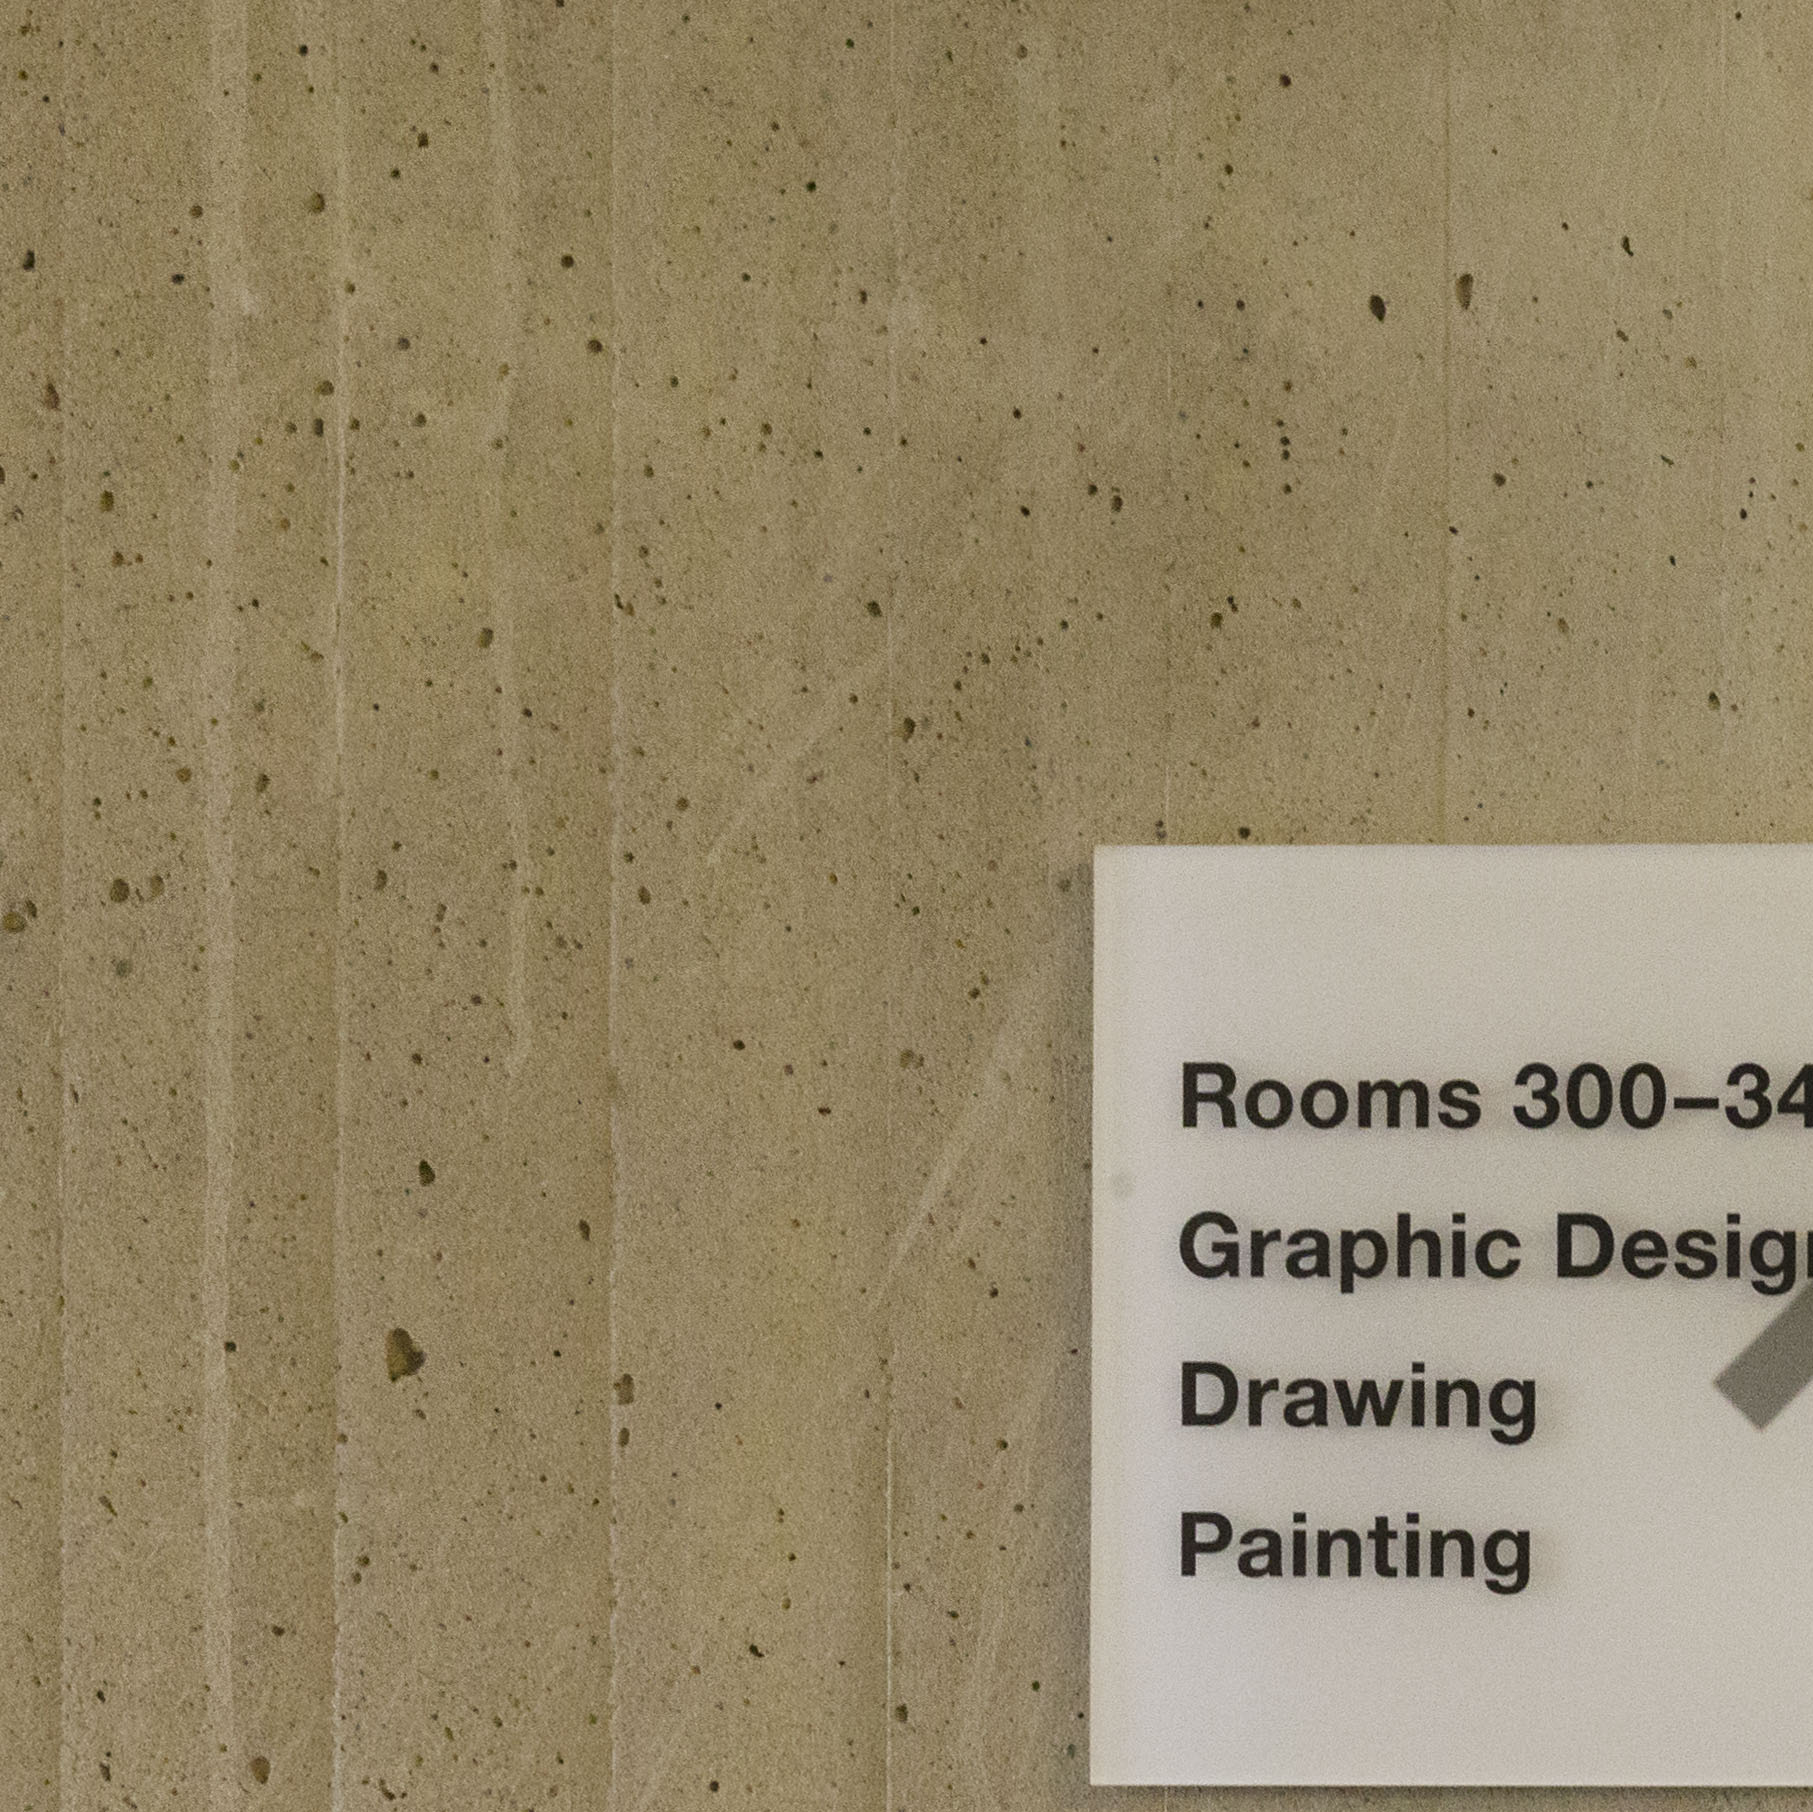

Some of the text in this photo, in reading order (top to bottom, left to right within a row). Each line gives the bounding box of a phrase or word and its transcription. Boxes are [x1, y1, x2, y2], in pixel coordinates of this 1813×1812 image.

[1183, 1063, 1481, 1130] Rooms
[1180, 1211, 1520, 1294] Graphic
[1182, 1362, 1536, 1446] Drawing
[1181, 1512, 1530, 1595] Painting
